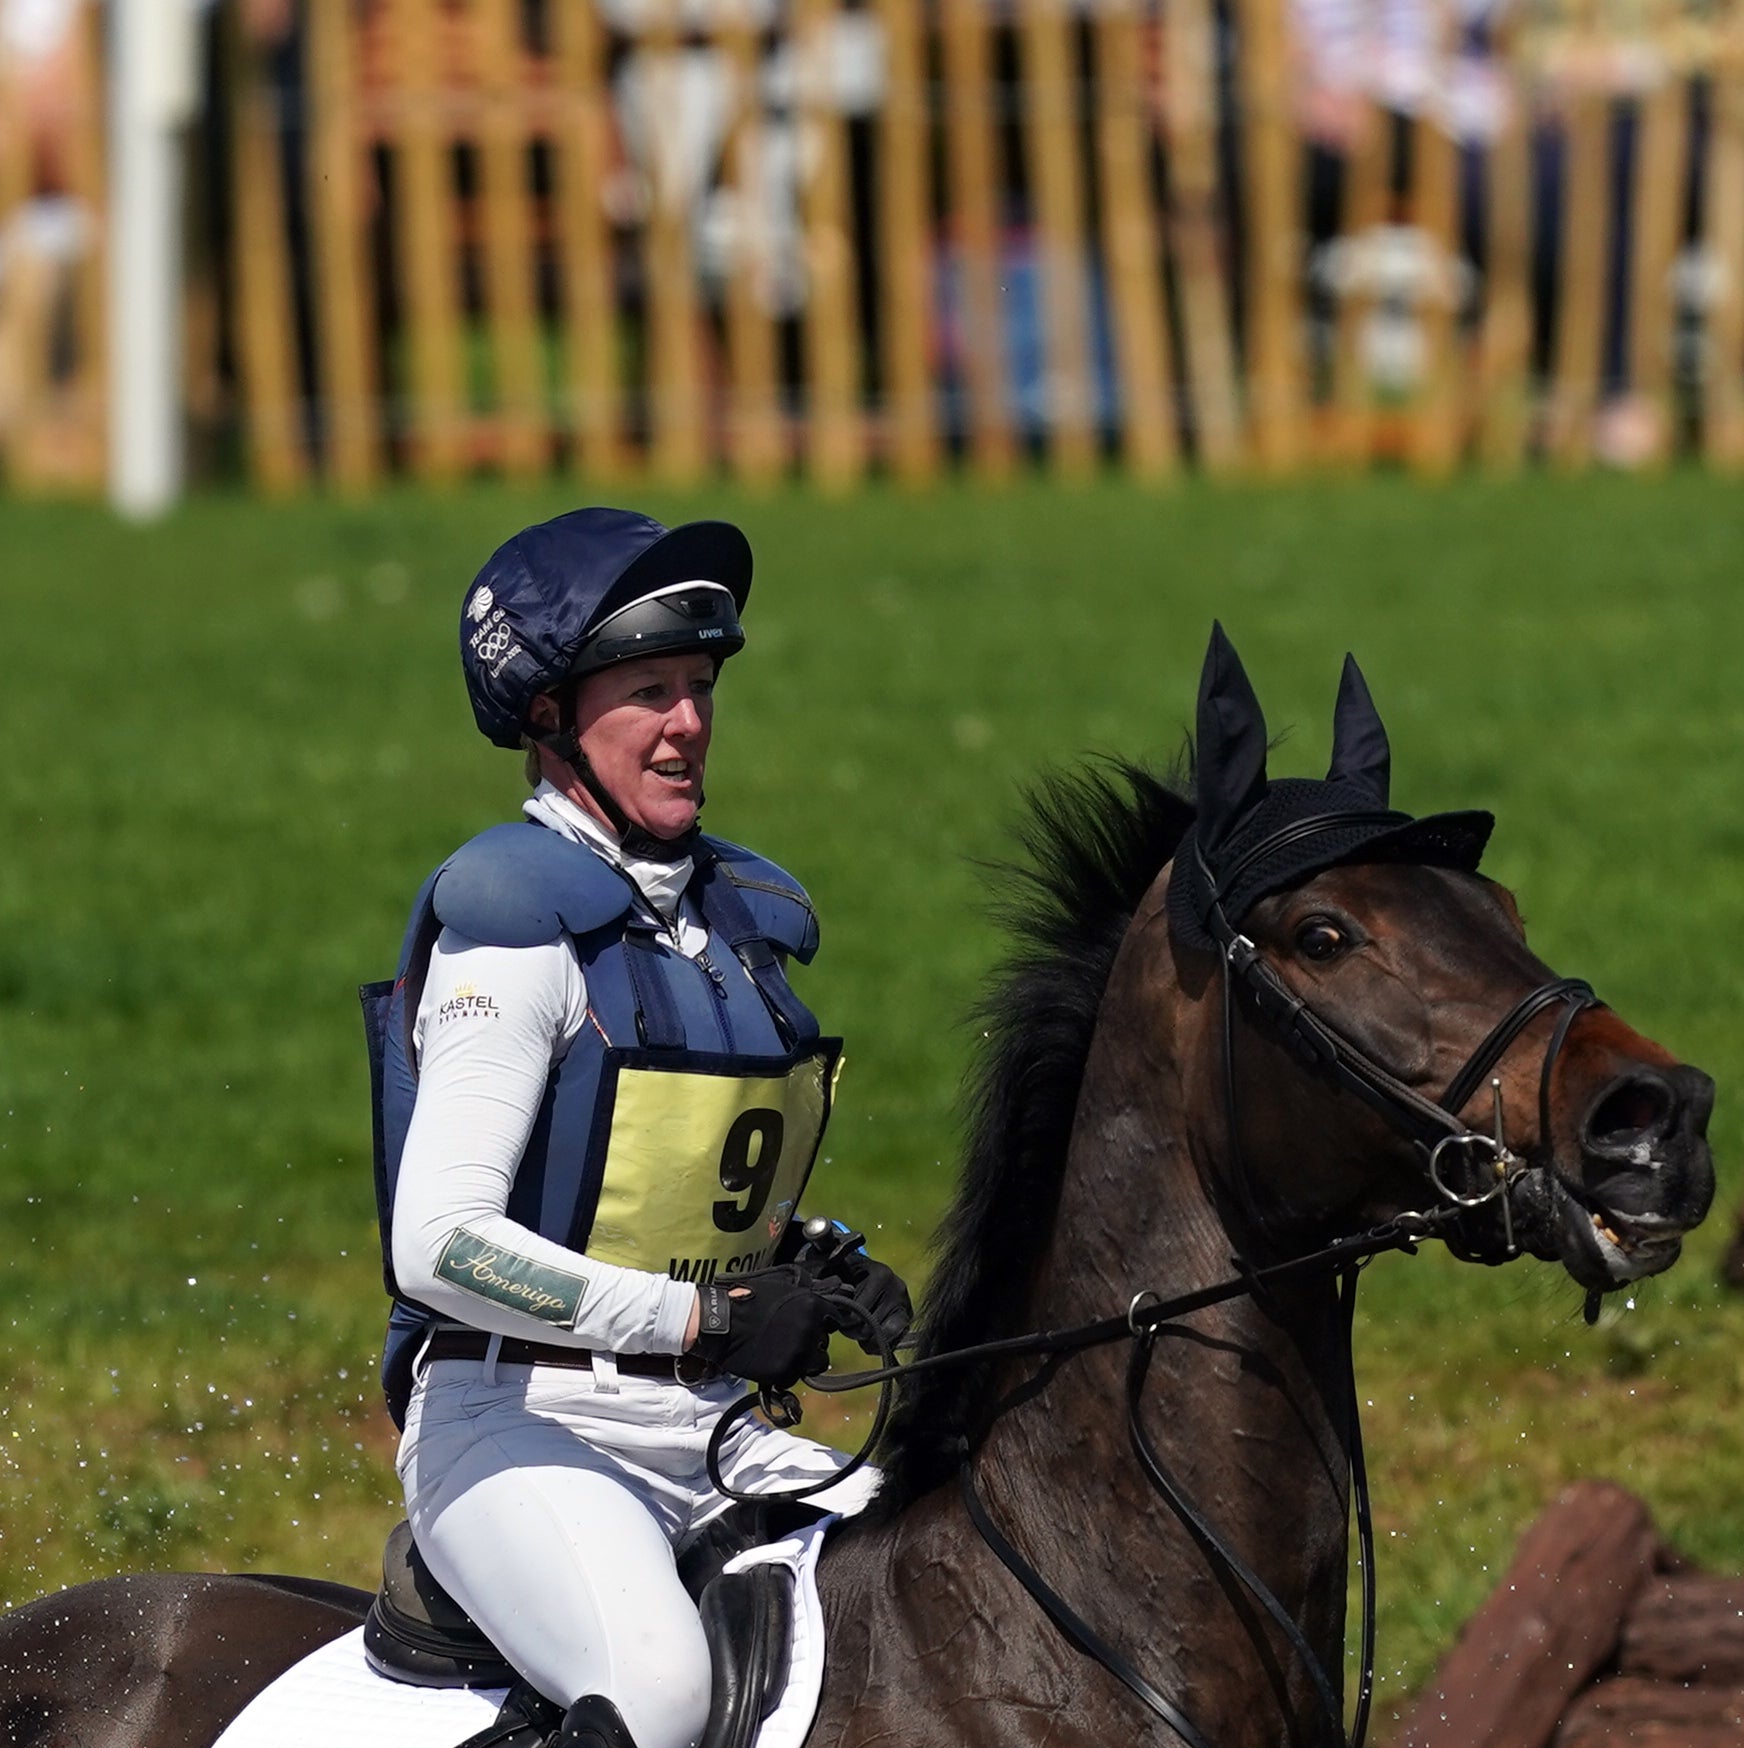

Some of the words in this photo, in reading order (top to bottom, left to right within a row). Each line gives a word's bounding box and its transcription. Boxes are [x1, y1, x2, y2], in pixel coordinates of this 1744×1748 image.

[469, 618, 493, 648] TEAM
[698, 628, 724, 639] uvex
[490, 657, 509, 678] London
[506, 644, 522, 660] 2012
[439, 996, 499, 1016] KASTEL
[712, 1108, 784, 1233] 9
[449, 1253, 566, 1311] Amerigo
